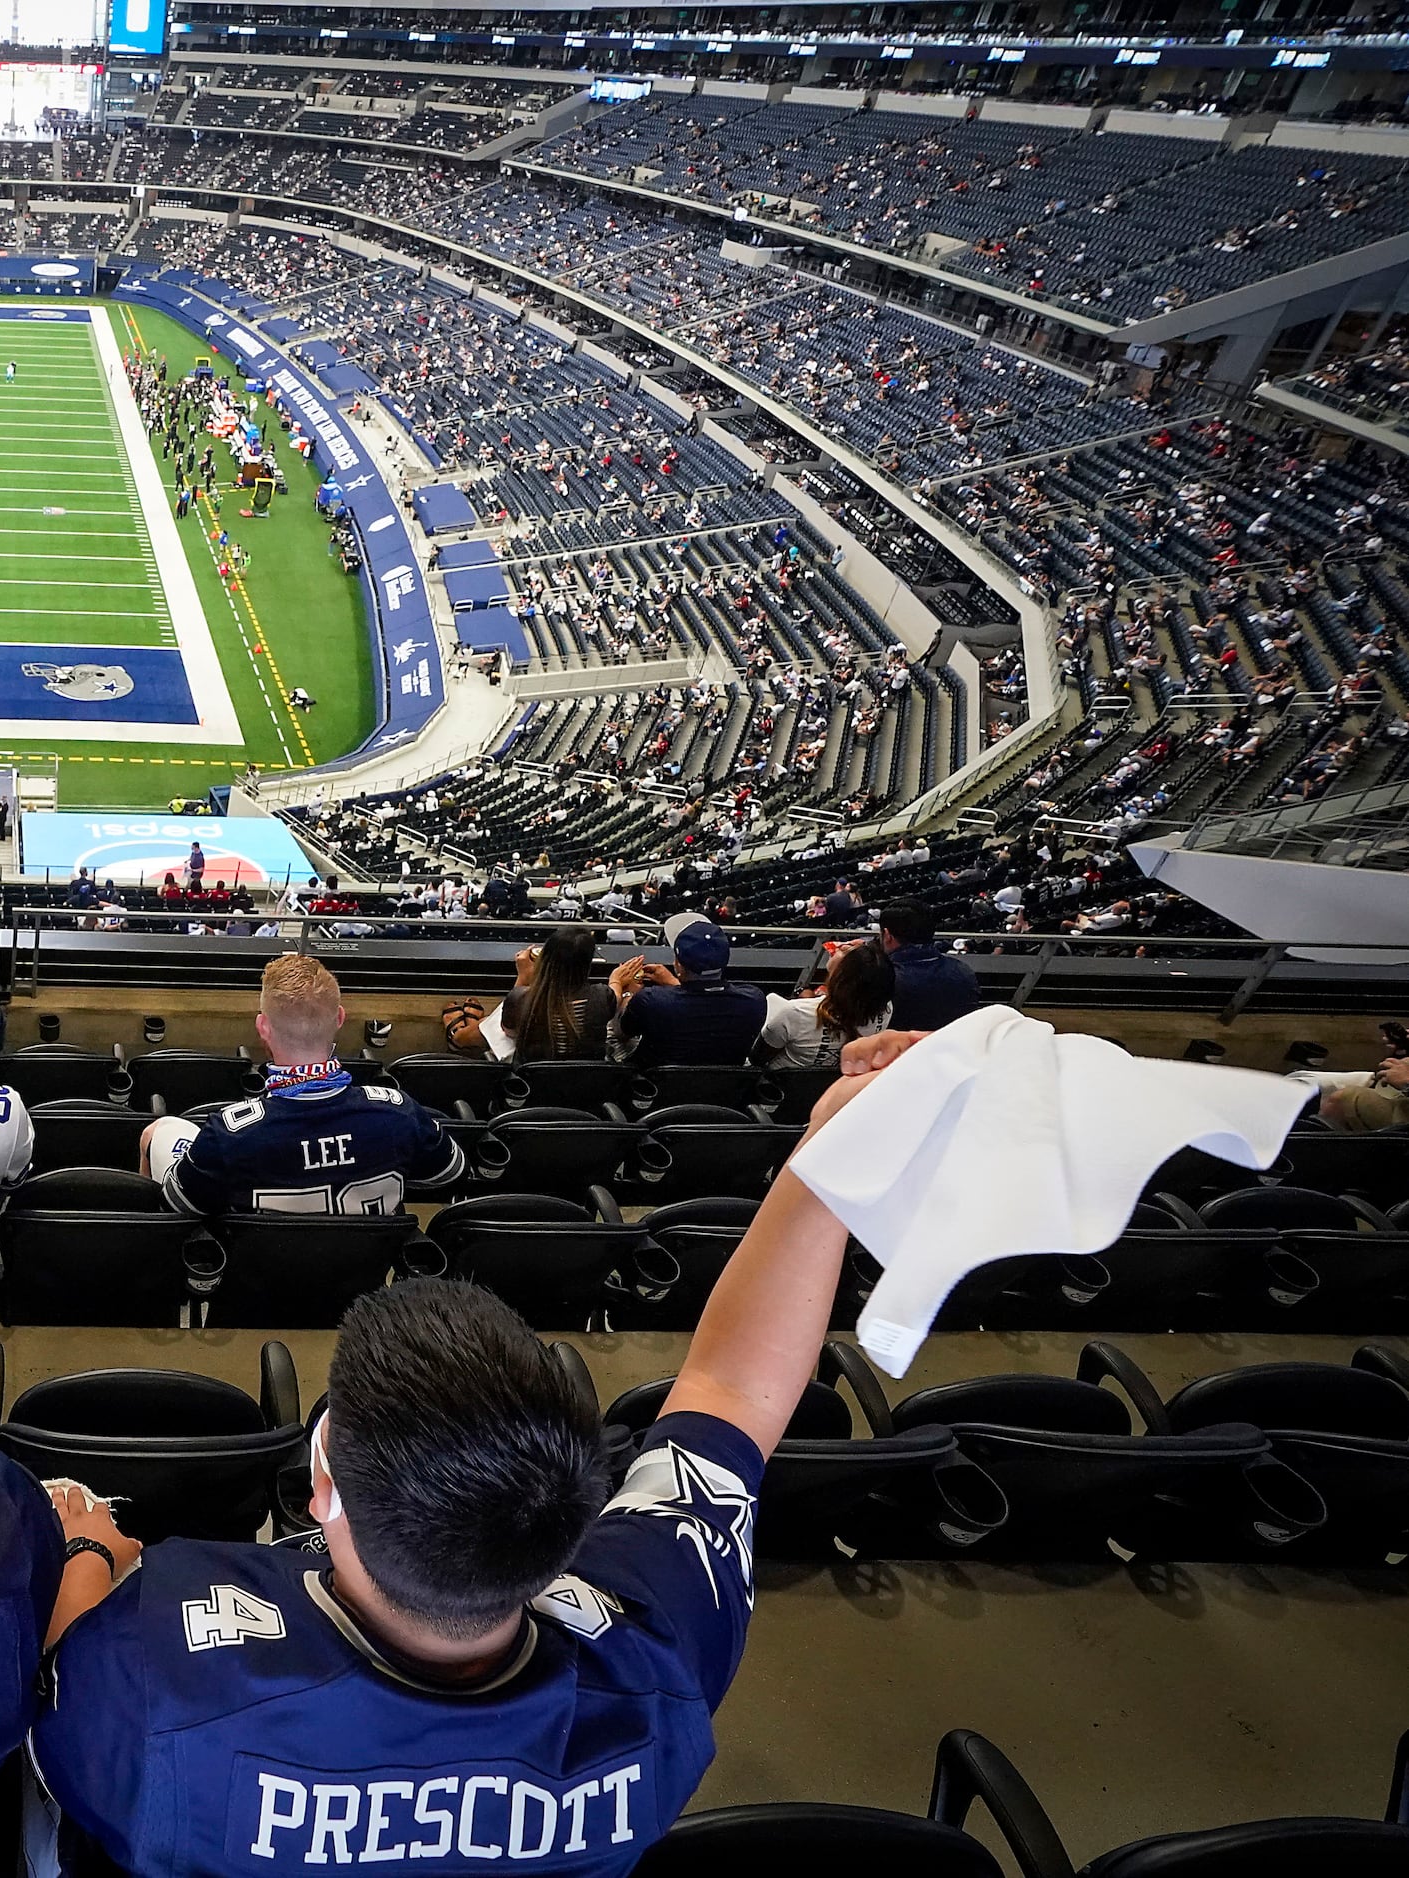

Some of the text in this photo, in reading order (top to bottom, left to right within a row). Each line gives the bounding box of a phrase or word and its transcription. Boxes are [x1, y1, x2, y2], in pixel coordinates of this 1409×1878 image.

[83, 822, 224, 838] pepsi
[300, 1133, 356, 1170] LEE
[181, 1584, 287, 1652] 4
[250, 1763, 642, 1864] PRESCOTT
